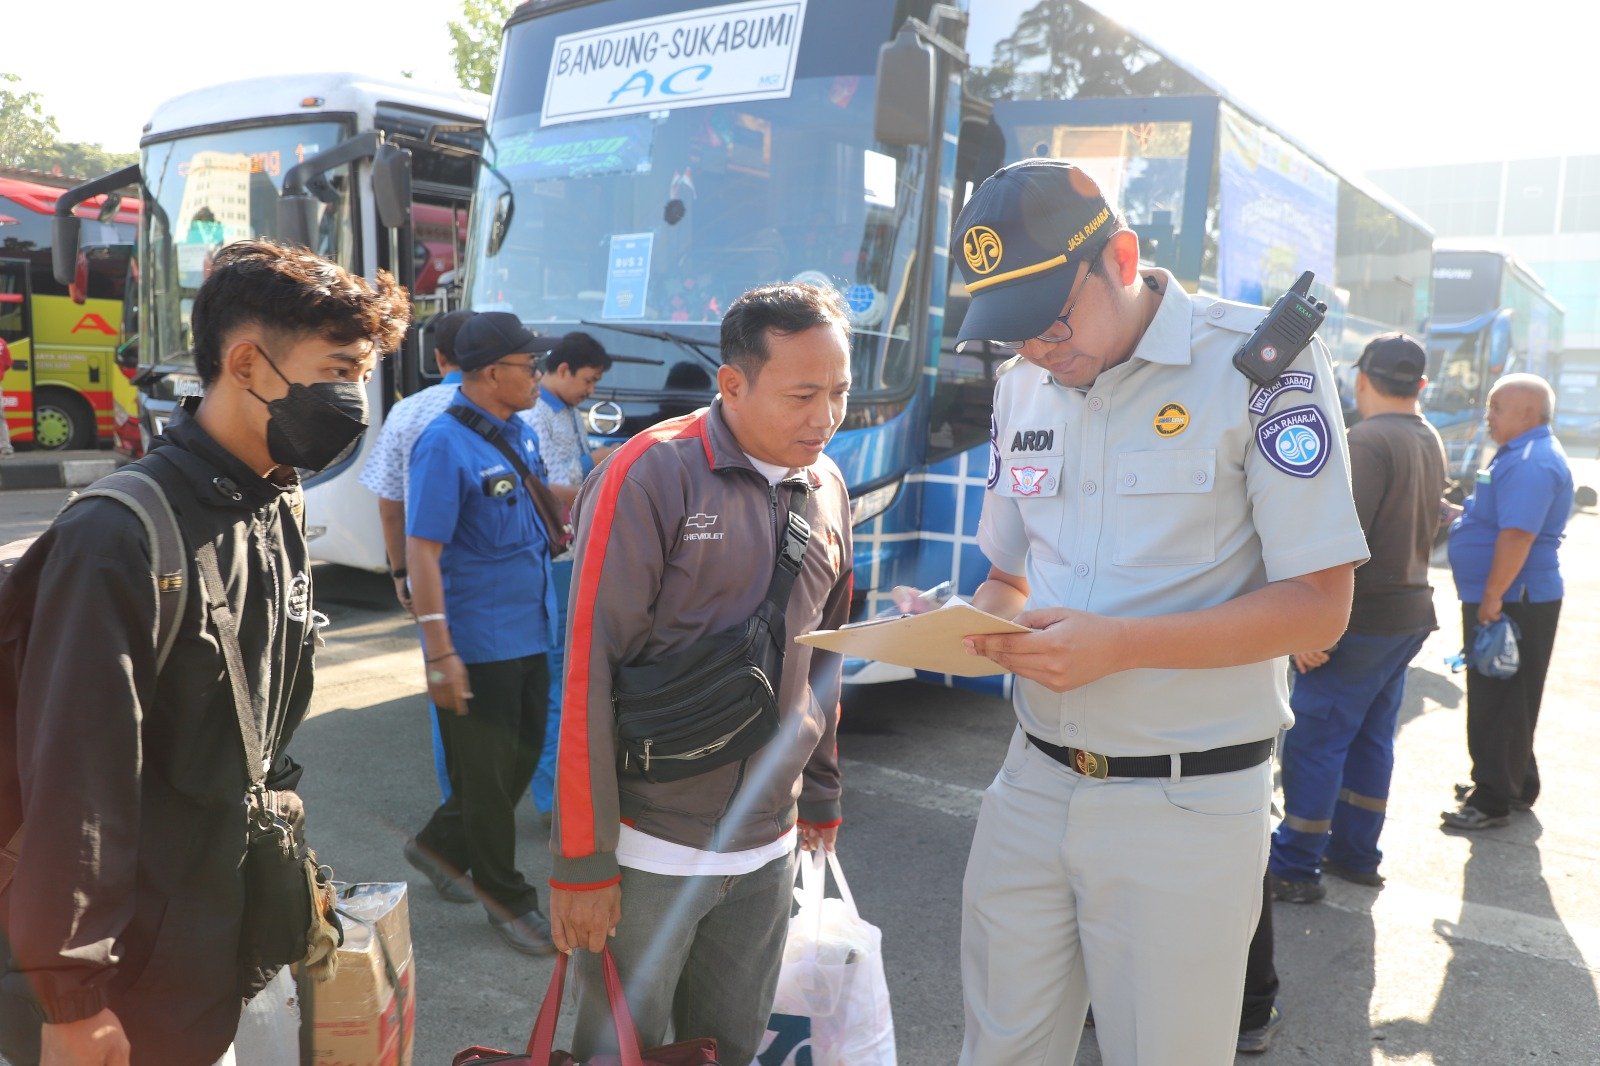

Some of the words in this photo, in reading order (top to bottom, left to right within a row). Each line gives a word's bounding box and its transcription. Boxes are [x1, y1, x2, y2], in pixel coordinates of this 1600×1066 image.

[557, 13, 793, 76] BANDUNG-SUKABUMI
[608, 64, 713, 104] AC
[1067, 231, 1086, 252] JASA
[616, 257, 636, 268] BUS
[1254, 381, 1282, 409] WILAYAH
[1284, 376, 1310, 387] JABAR
[1262, 423, 1282, 440] JASA
[1280, 413, 1317, 428] RAHARJA
[1010, 429, 1054, 453] ARDI
